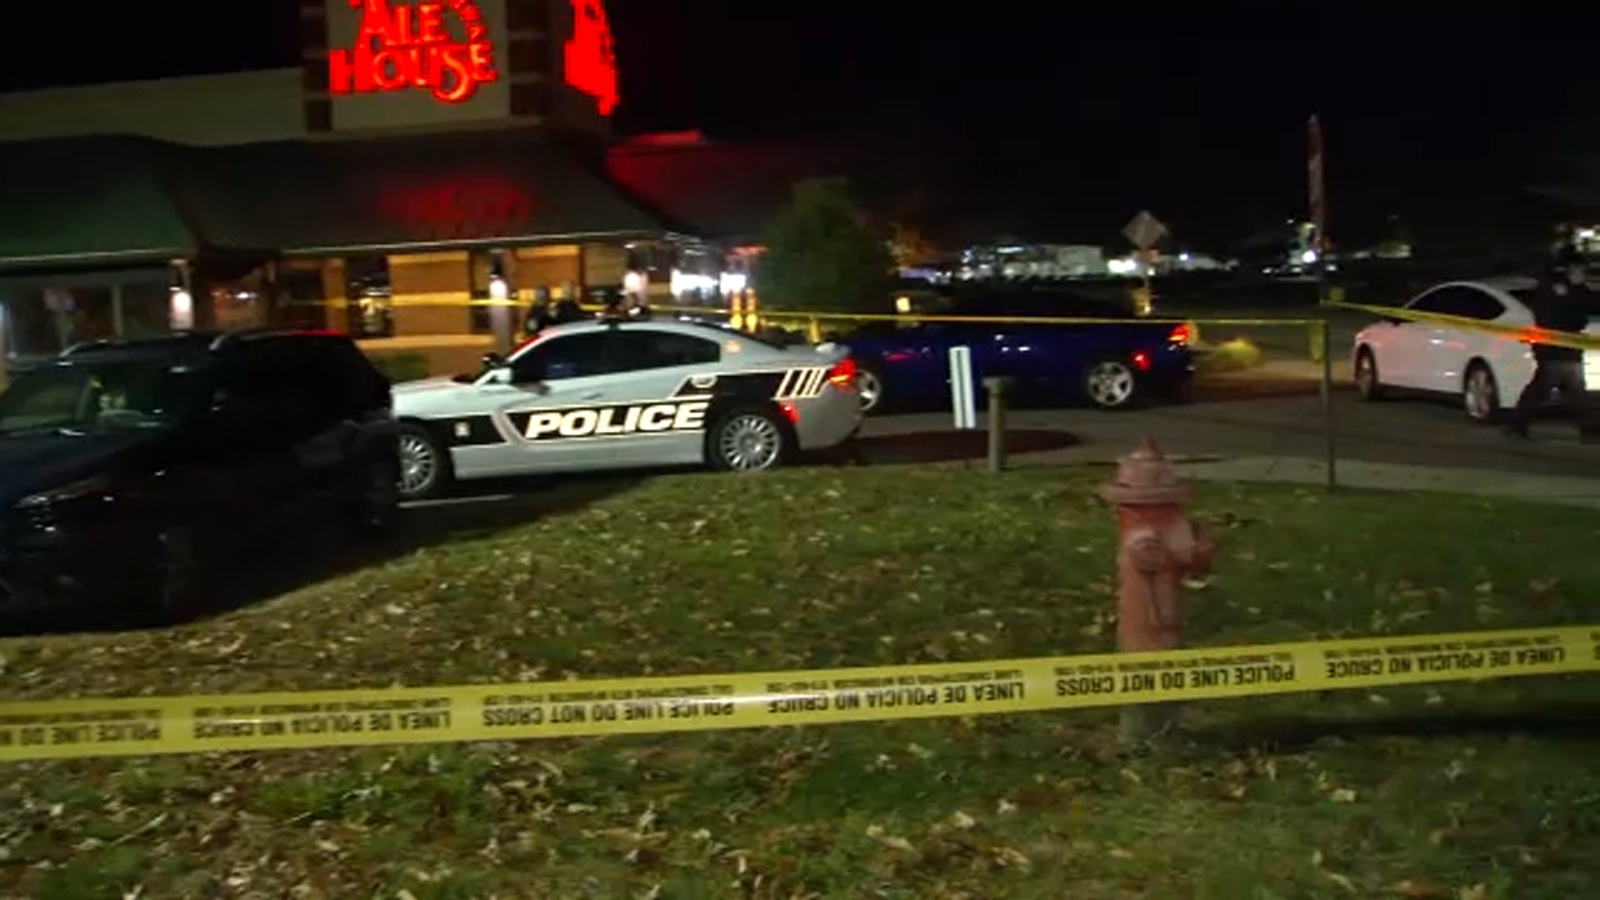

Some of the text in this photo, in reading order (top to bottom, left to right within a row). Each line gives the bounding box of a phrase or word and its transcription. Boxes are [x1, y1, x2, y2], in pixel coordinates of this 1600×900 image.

[354, 0, 450, 49] ALE
[328, 39, 499, 103] HOUSE
[525, 402, 709, 439] POLICE
[1389, 657, 1412, 675] NO
[1418, 652, 1485, 672] POLICIA
[1489, 650, 1511, 668] DE
[1517, 647, 1565, 666] LINEA
[1190, 669, 1229, 689] LINE
[1234, 664, 1295, 686] POLICE
[1325, 659, 1384, 679] CRUCE
[1055, 675, 1115, 697] CROSS
[1120, 674, 1156, 693] NOT
[1161, 671, 1186, 691] DO
[767, 682, 1026, 713] LINEA DE POLICIA NO CRUCE
[482, 702, 735, 727] POLICE LINE DO NOT CROSS
[50, 726, 91, 745] LINE
[96, 725, 162, 743] POLICE
[194, 711, 451, 740] LINEA DE POLICIA NO CRUCE
[20, 728, 45, 746] DO
